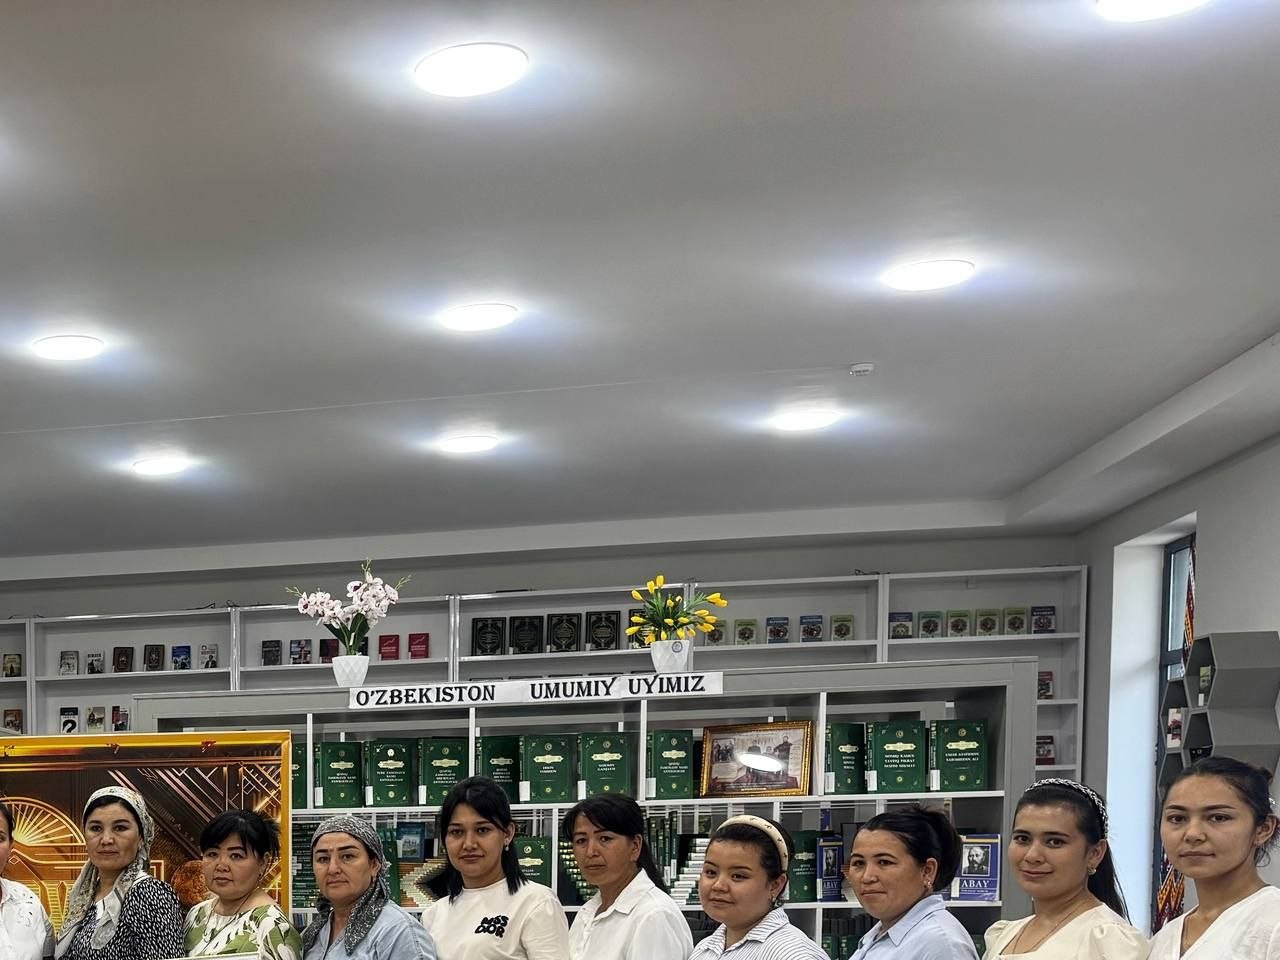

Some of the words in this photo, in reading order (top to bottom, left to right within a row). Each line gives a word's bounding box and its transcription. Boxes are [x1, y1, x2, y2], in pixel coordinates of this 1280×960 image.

[355, 685, 495, 706] O'ZBEKISTON
[530, 677, 618, 699] UMUMIY
[627, 673, 706, 695] UYIMIZ
[961, 879, 989, 888] ABAY
